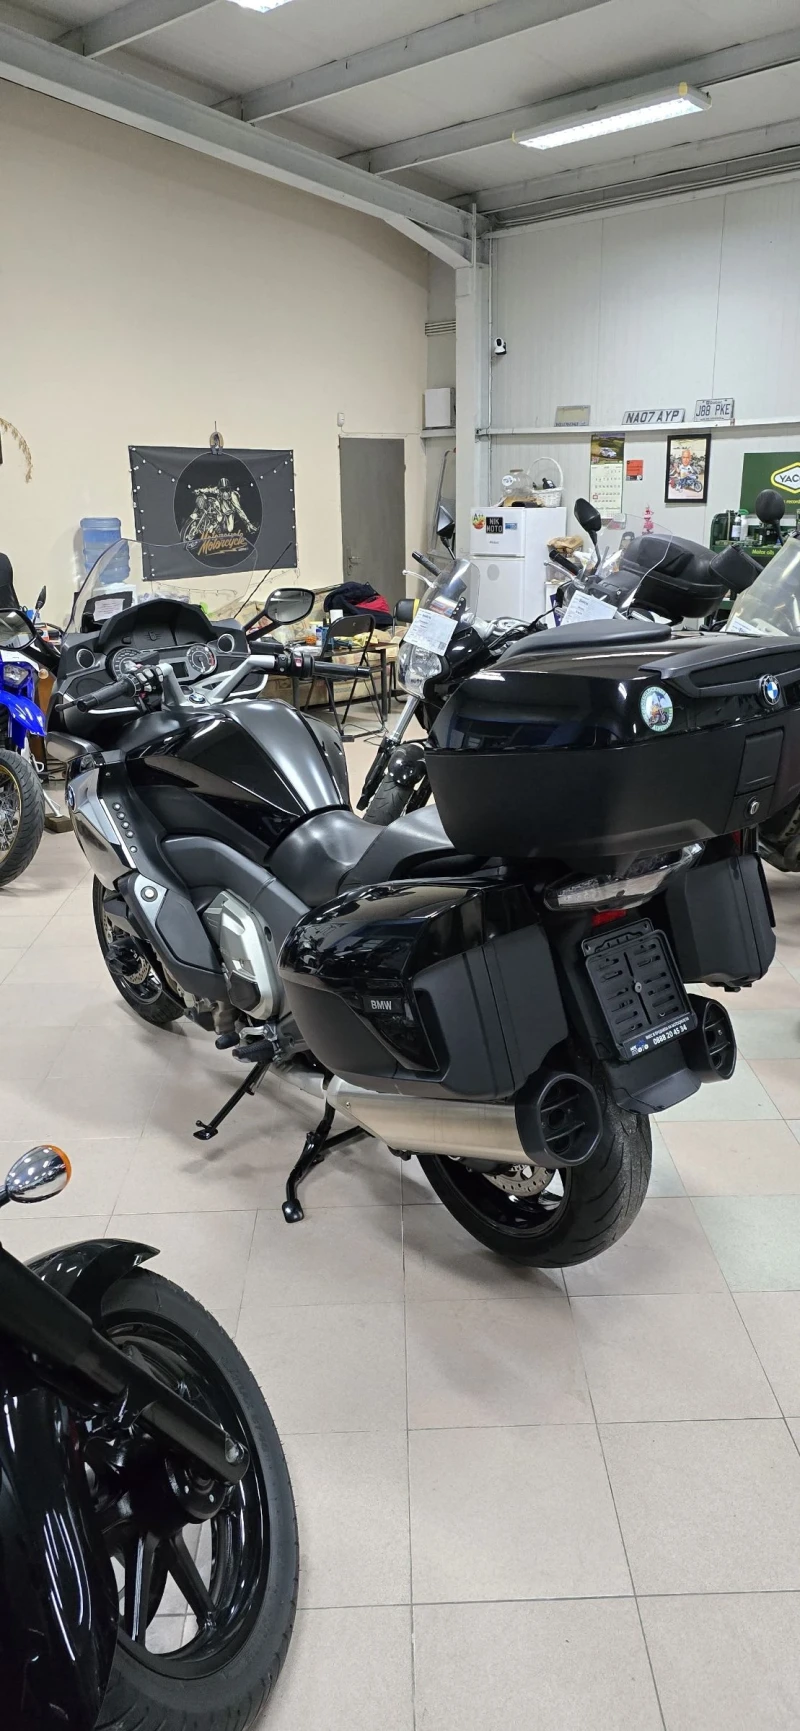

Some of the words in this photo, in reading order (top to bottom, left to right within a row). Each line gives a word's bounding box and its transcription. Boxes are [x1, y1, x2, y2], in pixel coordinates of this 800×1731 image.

[695, 404, 711, 417] J88
[714, 403, 731, 416] PKE
[625, 411, 655, 424] NA07
[656, 410, 680, 422] AYP
[780, 474, 800, 483] YAC
[486, 525, 503, 533] MOTO
[197, 536, 247, 556] Motorcycle
[370, 999, 392, 1011] BMW
[666, 1031, 674, 1039] 20
